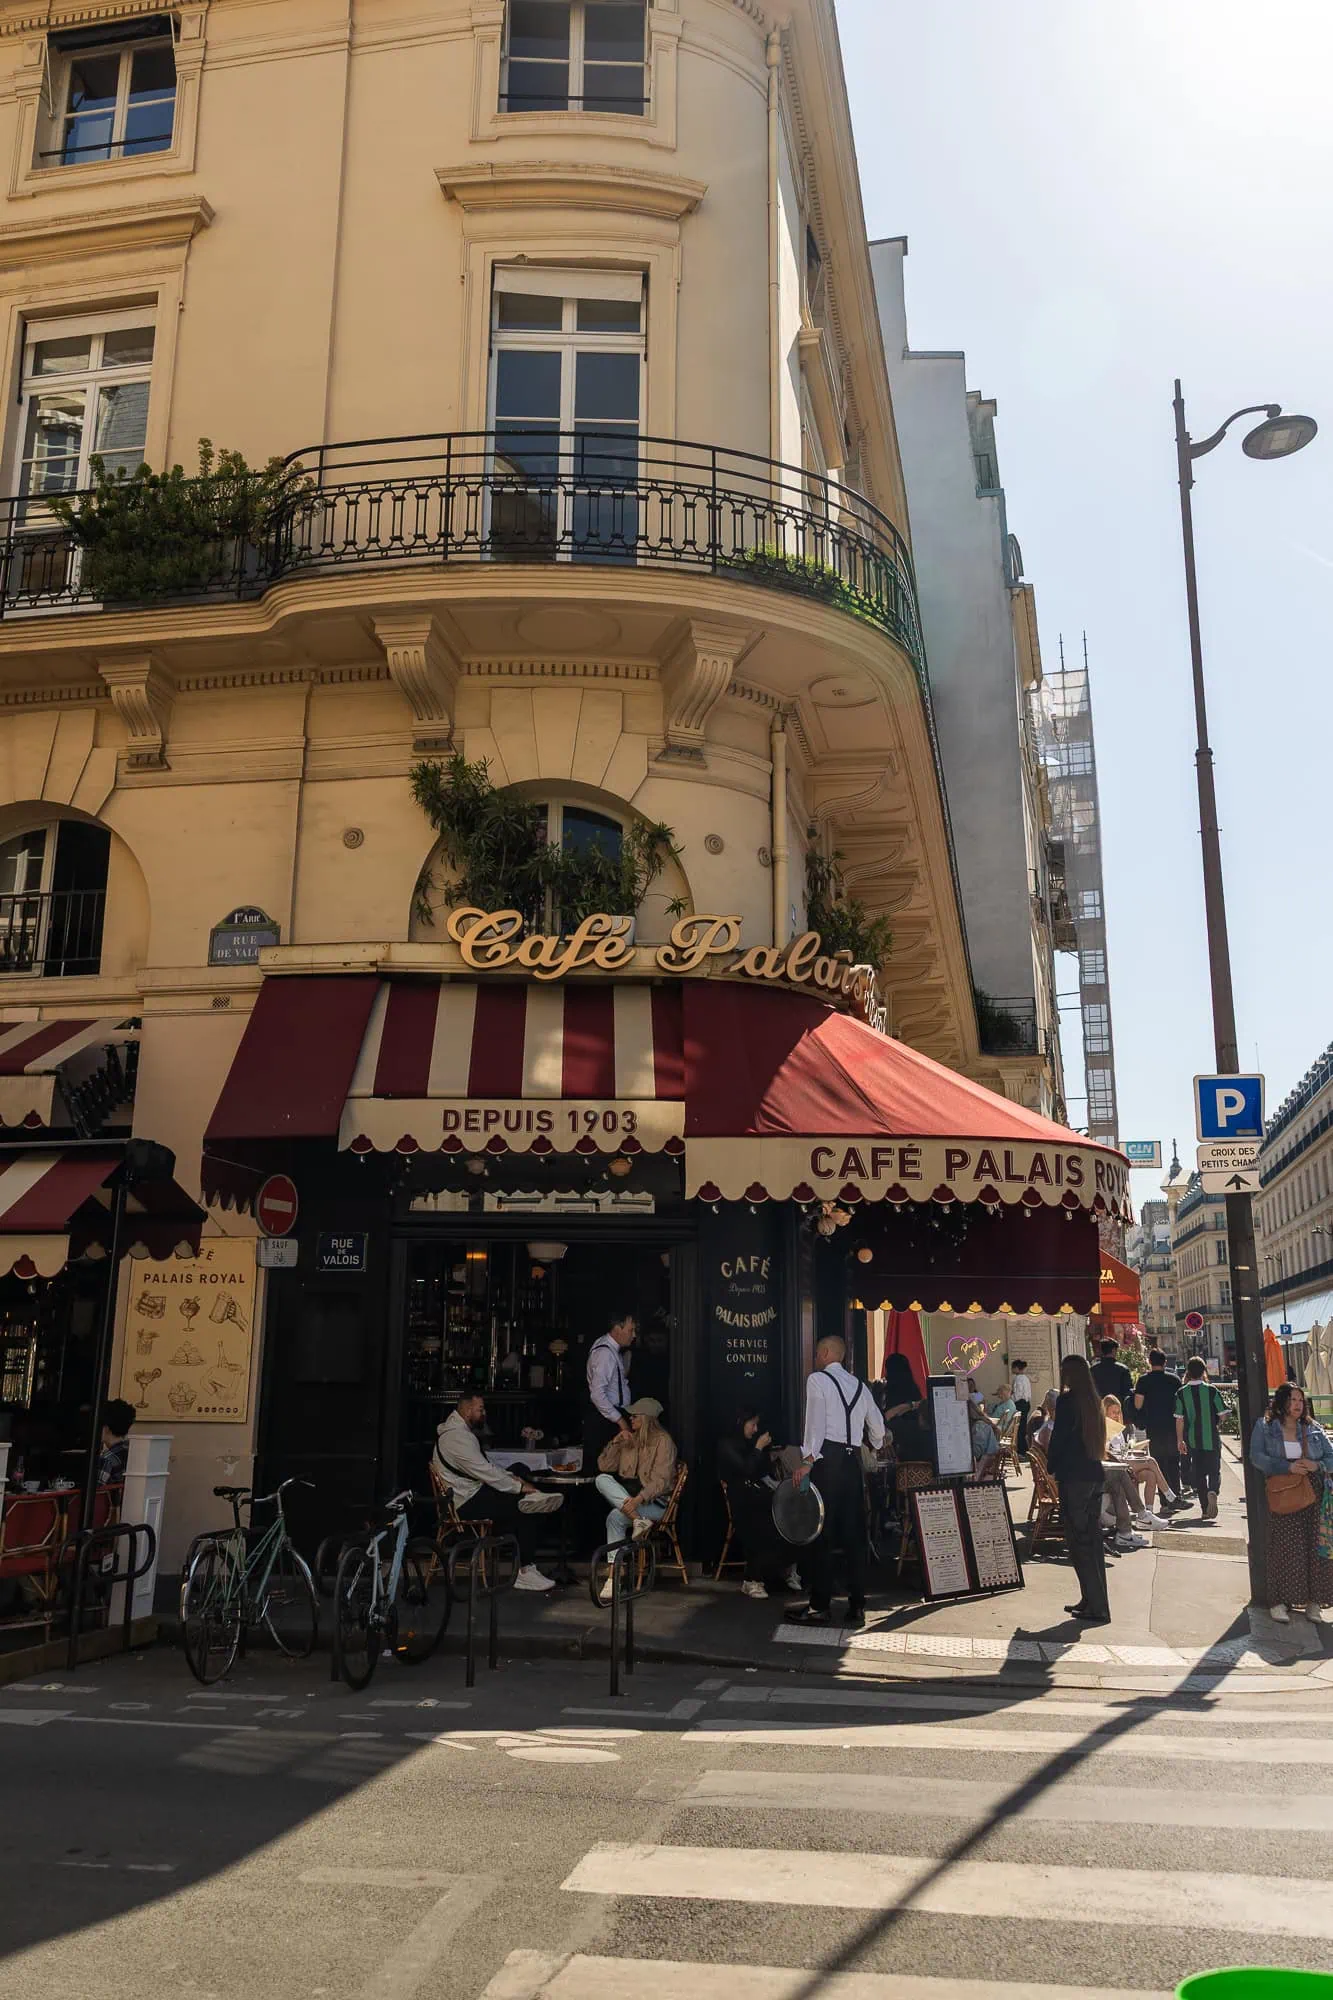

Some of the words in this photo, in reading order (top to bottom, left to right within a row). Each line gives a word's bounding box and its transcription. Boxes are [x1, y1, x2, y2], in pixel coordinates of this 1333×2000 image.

[233, 935, 257, 945] RUE
[447, 906, 635, 980] Café
[217, 949, 231, 958] DE
[1215, 1088, 1246, 1128] P
[442, 1109, 554, 1133] DEPUIS
[567, 1110, 639, 1134] 1903
[1211, 1148, 1236, 1157] CROIX
[1238, 1147, 1256, 1156] DES
[810, 1143, 922, 1180] CAFÉ
[945, 1148, 1085, 1187] PALAIS
[1201, 1159, 1230, 1169] PETITS
[271, 1240, 289, 1249] SAUF
[331, 1239, 353, 1249] RUE
[323, 1255, 360, 1265] VALOIS
[721, 1255, 771, 1279] CAFÉ
[143, 1273, 193, 1284] PALAIS
[199, 1273, 246, 1284] ROYAL
[715, 1305, 750, 1328] PALAIS
[751, 1306, 777, 1328] ROYAL
[727, 1339, 768, 1348] SERVICE
[726, 1353, 768, 1363] CONTINU
